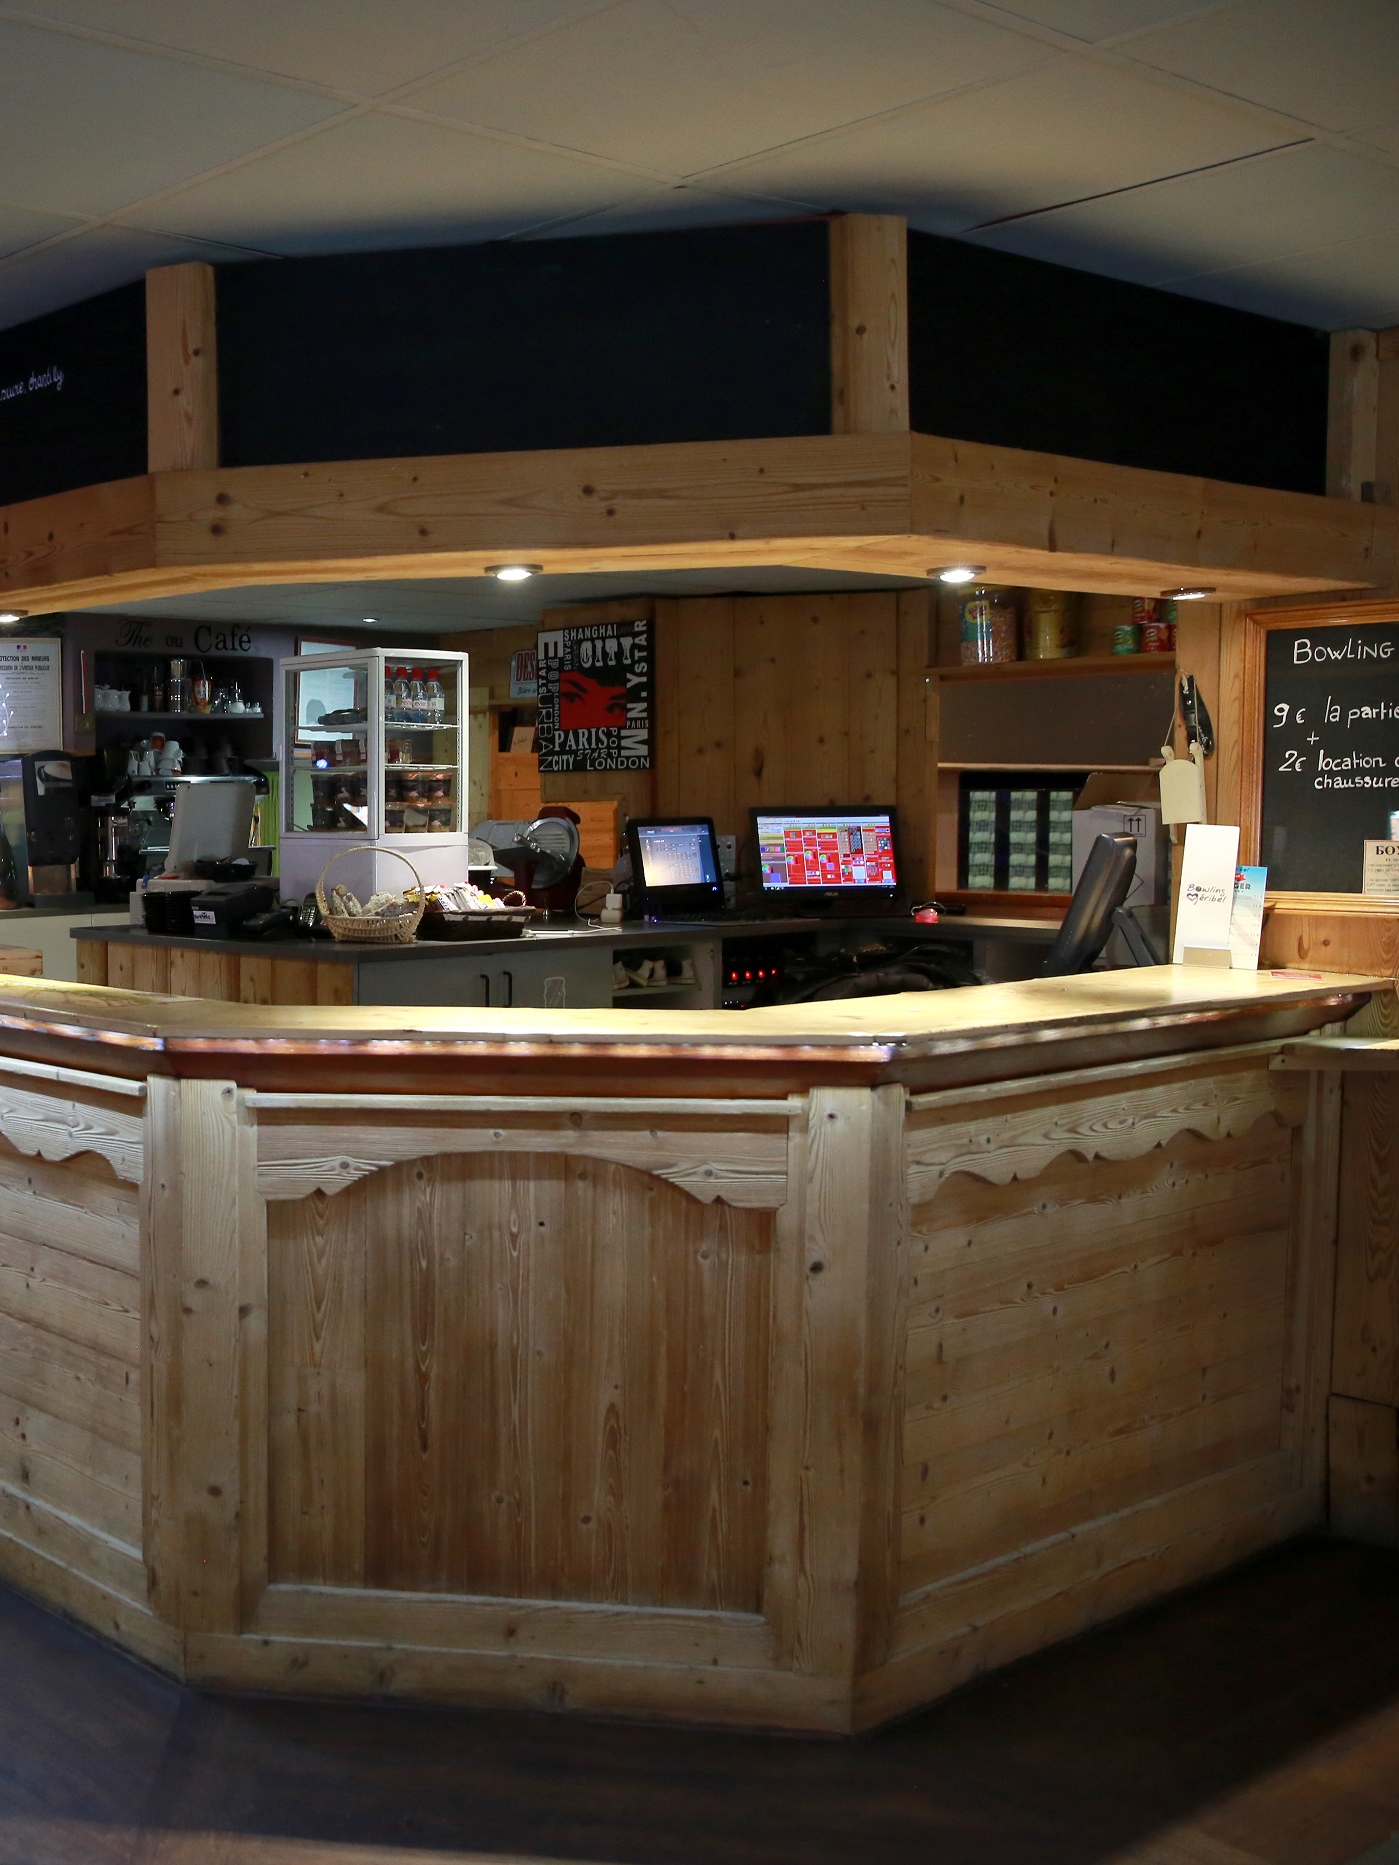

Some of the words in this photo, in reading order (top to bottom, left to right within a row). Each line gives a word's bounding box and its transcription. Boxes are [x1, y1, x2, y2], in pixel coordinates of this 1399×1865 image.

[166, 635, 183, 648] ou
[194, 622, 252, 653] Café
[564, 624, 617, 641] SHANGHAI
[634, 620, 647, 673] STAR
[516, 652, 537, 681] DES
[580, 636, 634, 669] CITY
[539, 659, 547, 694] STAR
[548, 659, 559, 692] POP
[627, 720, 649, 729] PARIS
[1273, 703, 1290, 728] 9
[1325, 696, 1341, 723] la
[538, 693, 553, 770] URBAN
[554, 727, 608, 750] PARIS
[609, 728, 618, 758] POP
[553, 755, 574, 771] CITY
[577, 748, 608, 759] STAR
[587, 757, 650, 770] LONDON
[1318, 749, 1387, 771] location
[1187, 883, 1226, 897] Bowling
